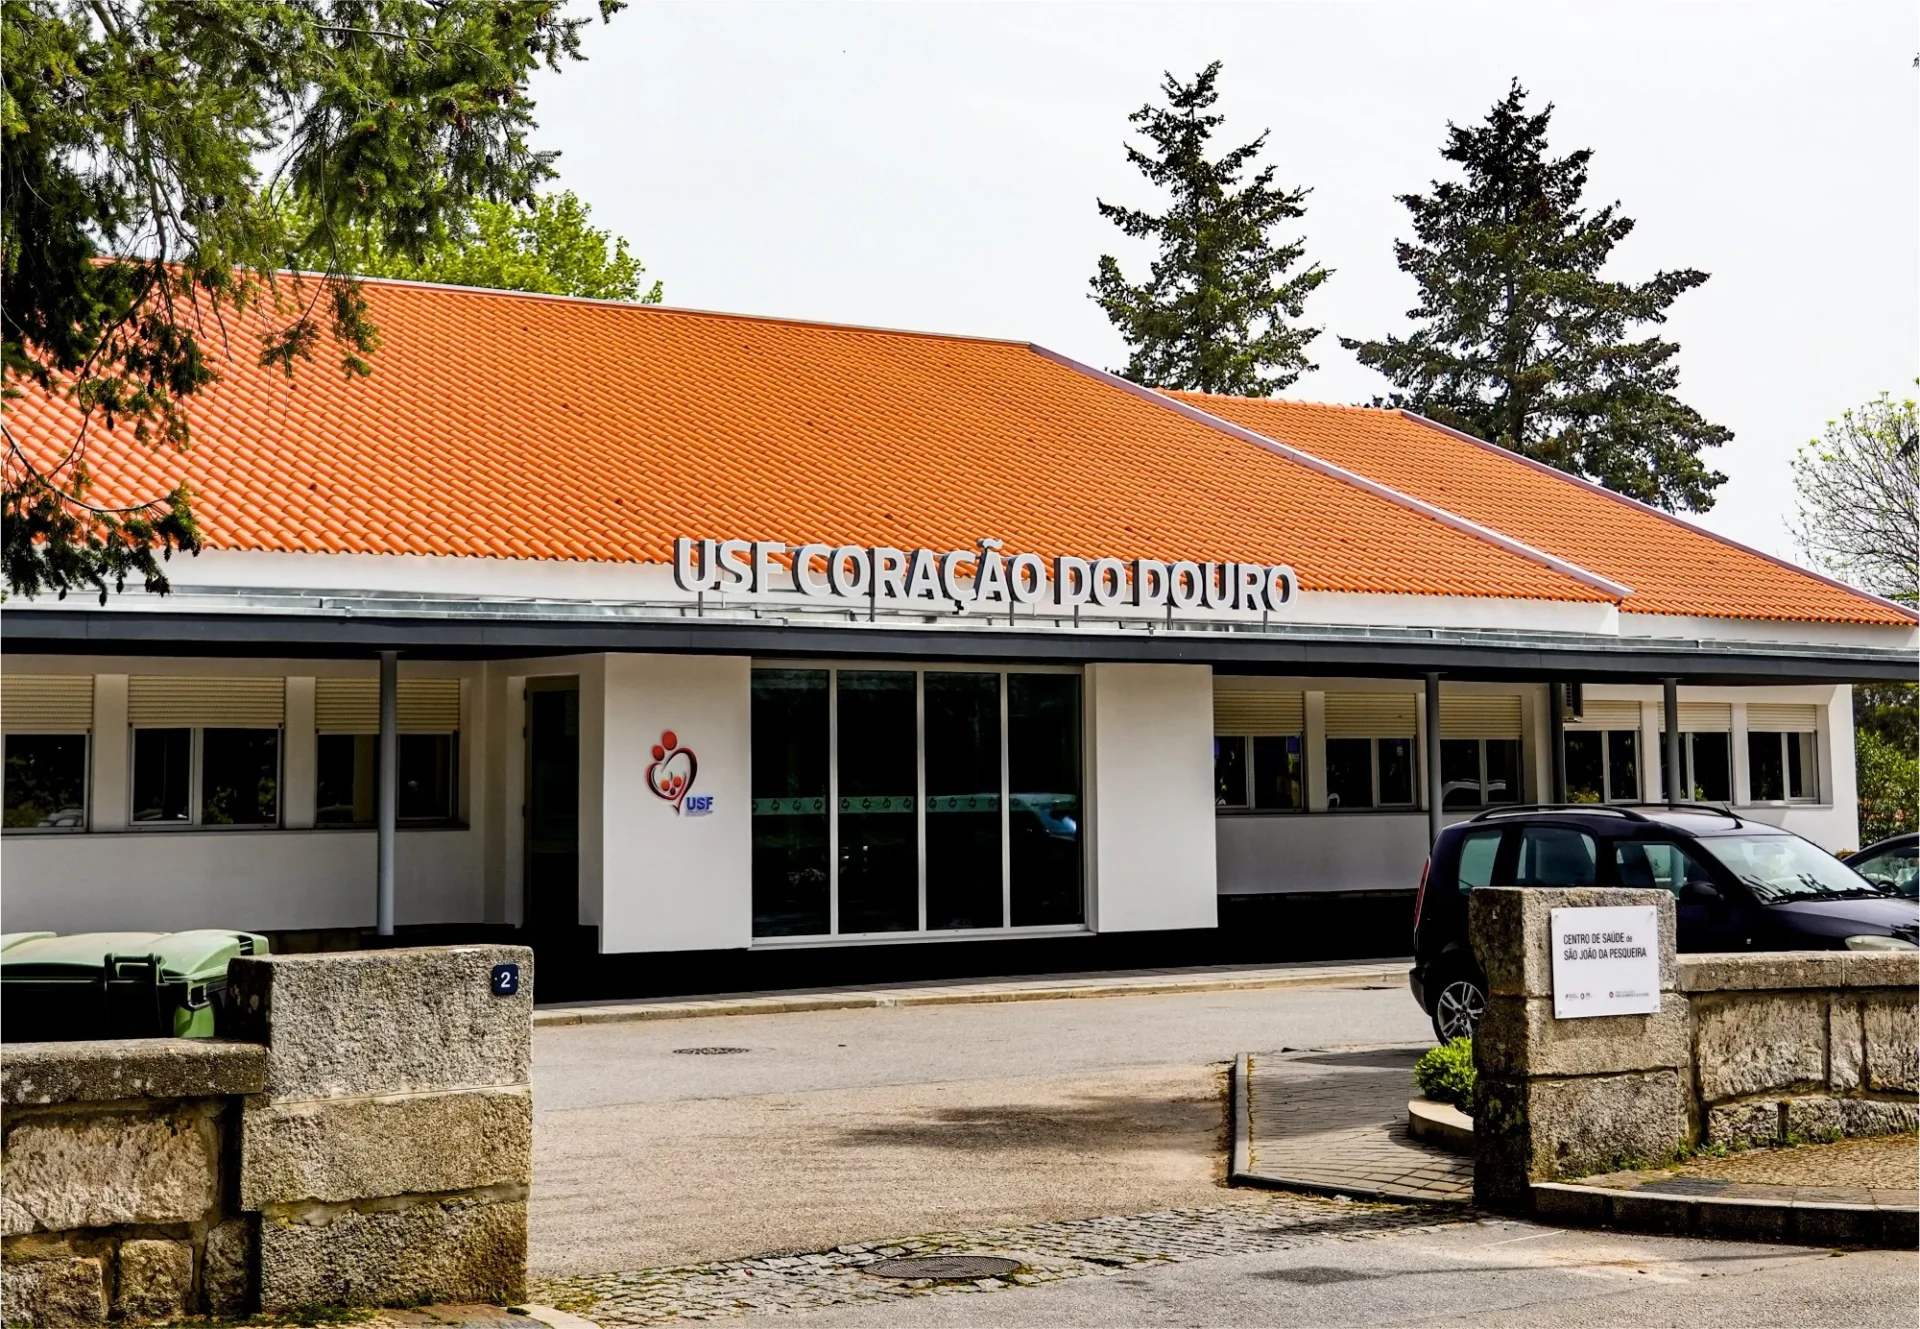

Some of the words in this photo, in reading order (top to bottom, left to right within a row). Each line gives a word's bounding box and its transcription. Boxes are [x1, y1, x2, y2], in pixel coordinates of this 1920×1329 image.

[674, 537, 786, 593] USF
[793, 538, 1047, 616] CORAÇÃO
[1054, 556, 1128, 608] DO
[1133, 559, 1299, 613] DOURO
[686, 796, 714, 811] USF
[1563, 933, 1590, 945] CENTRO
[1591, 932, 1601, 944] DE
[1602, 930, 1625, 943] SAÚDE
[1626, 935, 1633, 943] de
[1563, 947, 1578, 961] SÃO
[1579, 946, 1597, 960] JOÃO
[1598, 949, 1608, 959] DA
[1609, 947, 1647, 959] PESQUEIRA
[500, 971, 511, 988] 2
